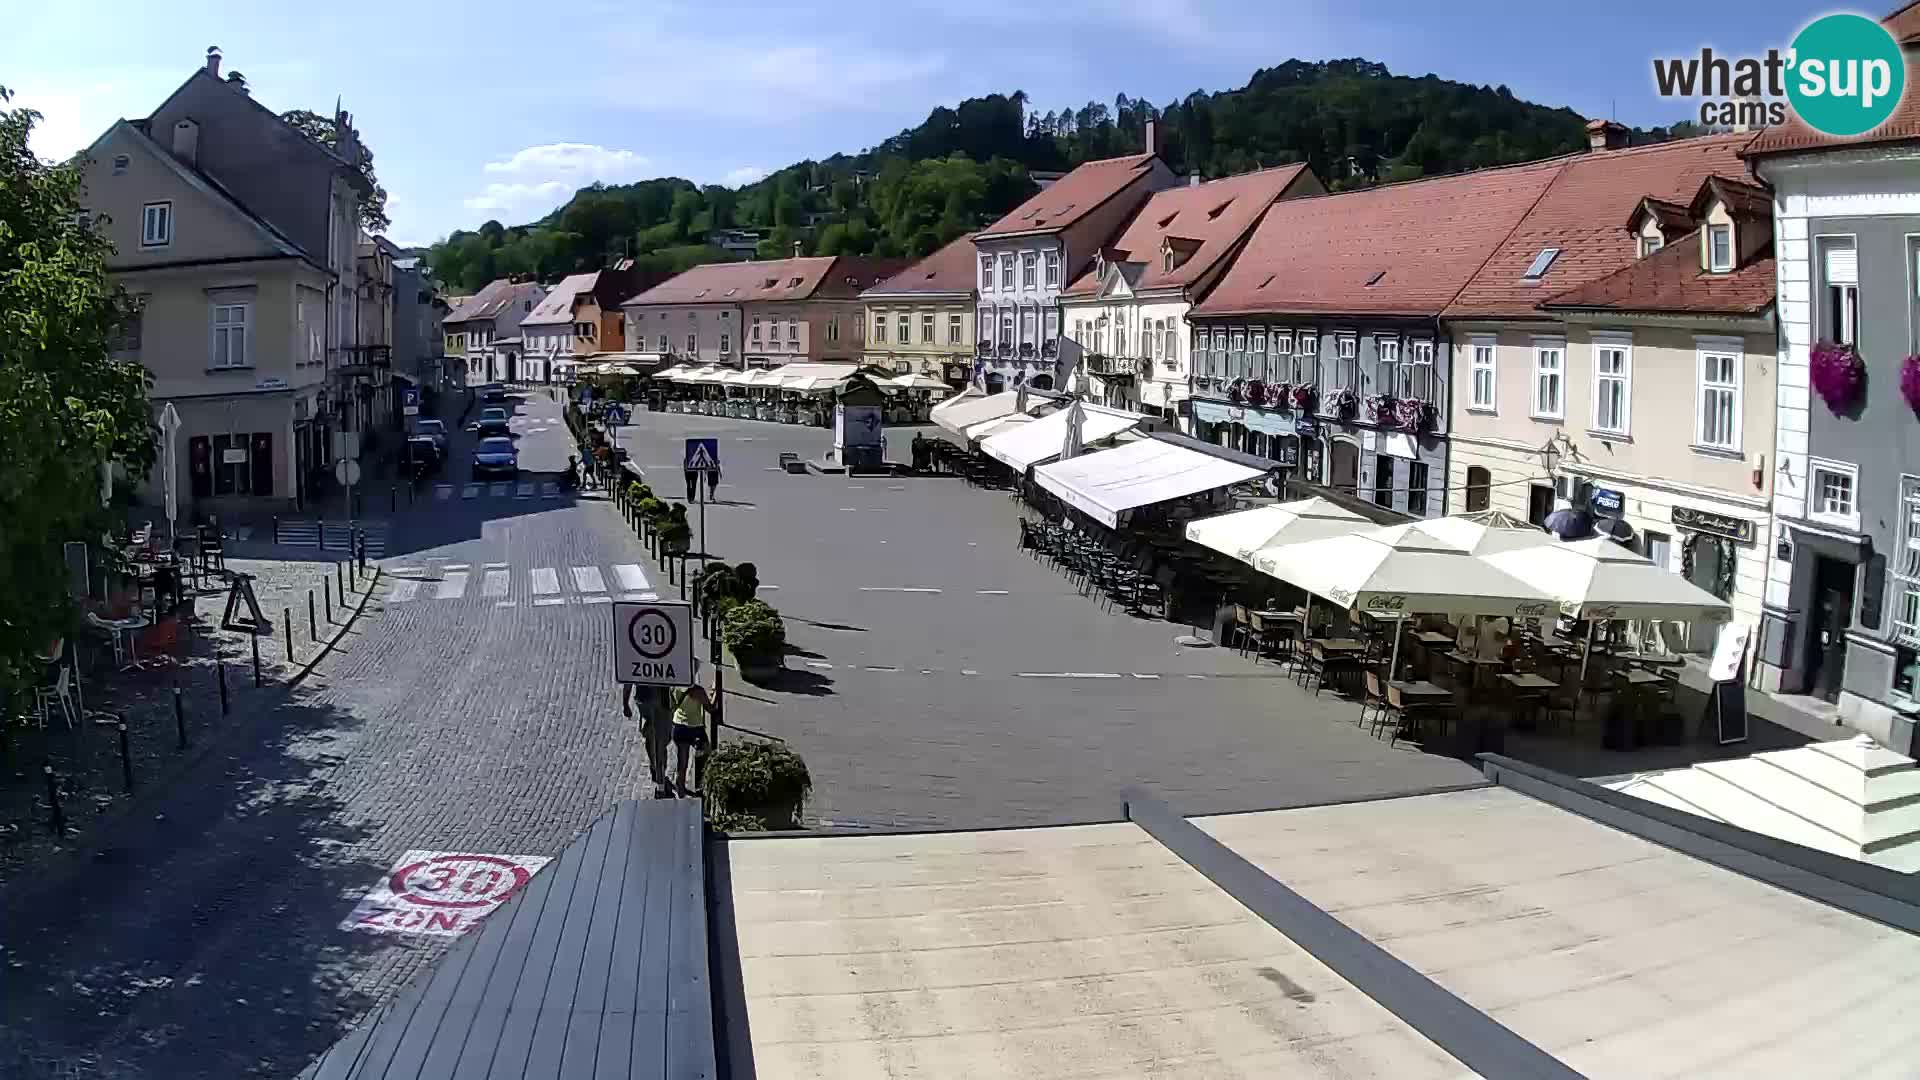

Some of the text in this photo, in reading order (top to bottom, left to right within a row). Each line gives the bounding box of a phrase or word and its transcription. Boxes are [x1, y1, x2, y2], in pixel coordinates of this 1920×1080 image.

[641, 624, 665, 645] 30
[631, 662, 676, 678] ZONA
[406, 867, 503, 892] 30
